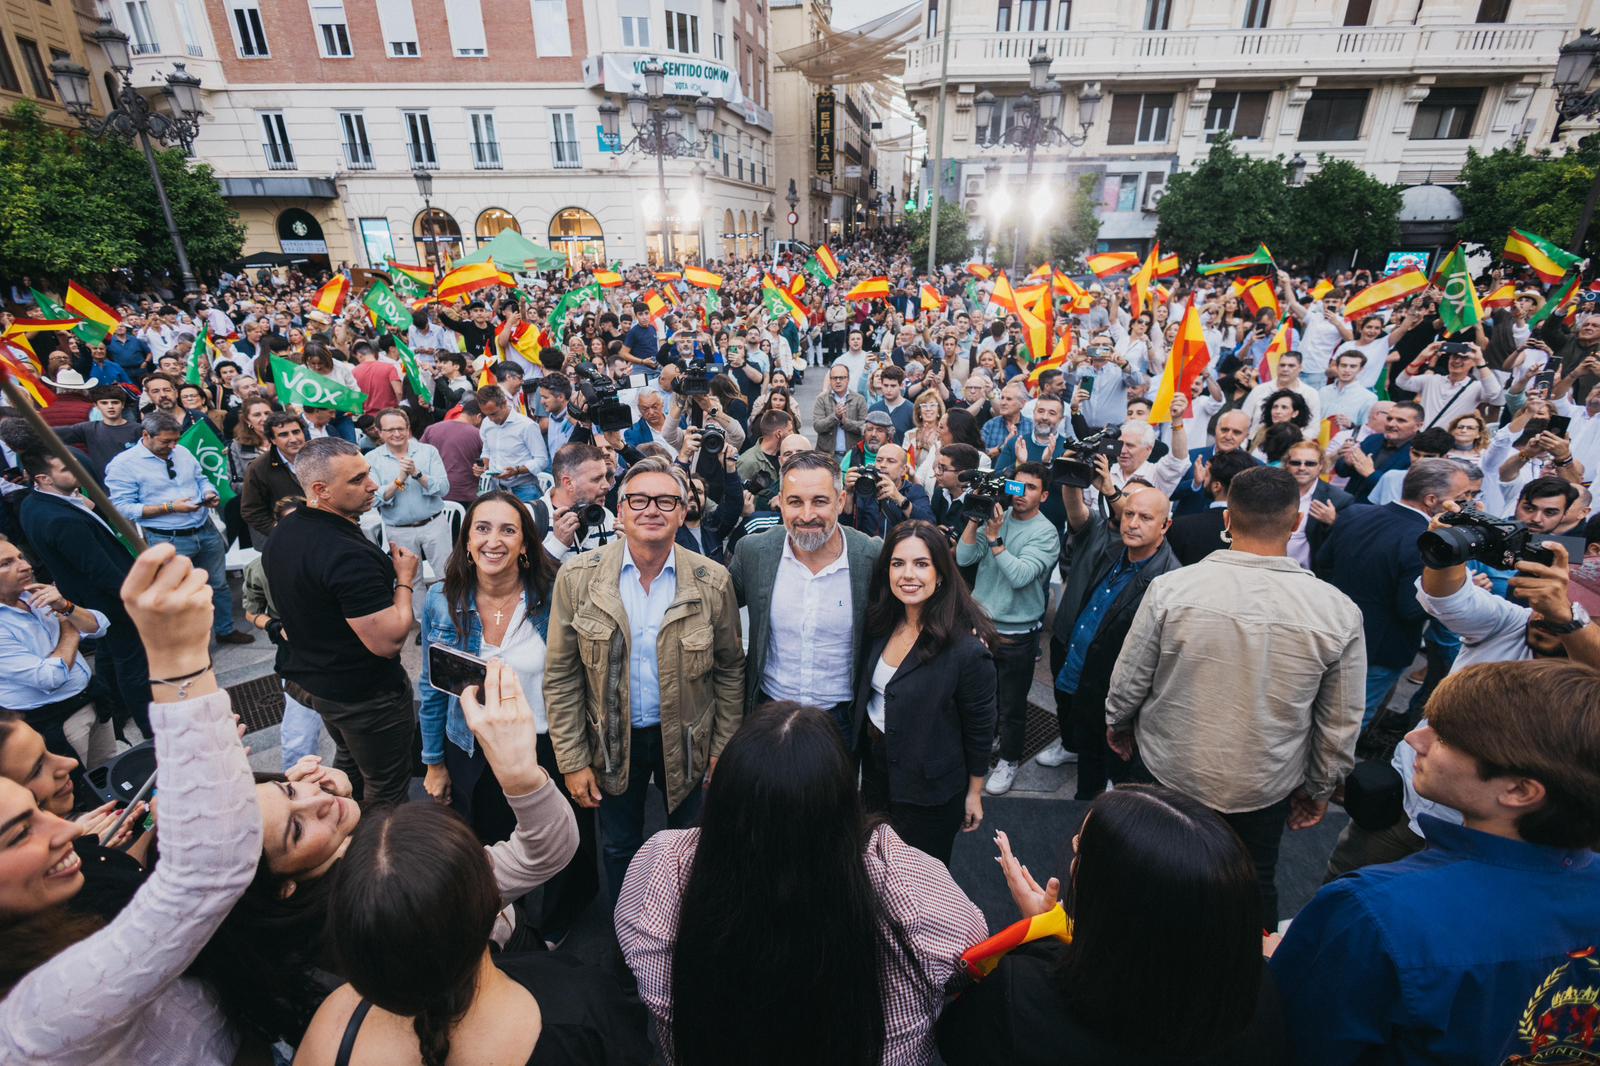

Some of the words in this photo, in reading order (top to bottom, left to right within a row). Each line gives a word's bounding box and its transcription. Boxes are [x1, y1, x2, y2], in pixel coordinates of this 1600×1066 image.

[663, 61, 701, 78] SENTIDO
[674, 82, 689, 90] VOTA
[391, 271, 420, 293] VOX
[377, 292, 406, 324] VOX
[282, 371, 343, 406] VOX
[196, 438, 229, 486] VOX
[1009, 484, 1021, 493] tve
